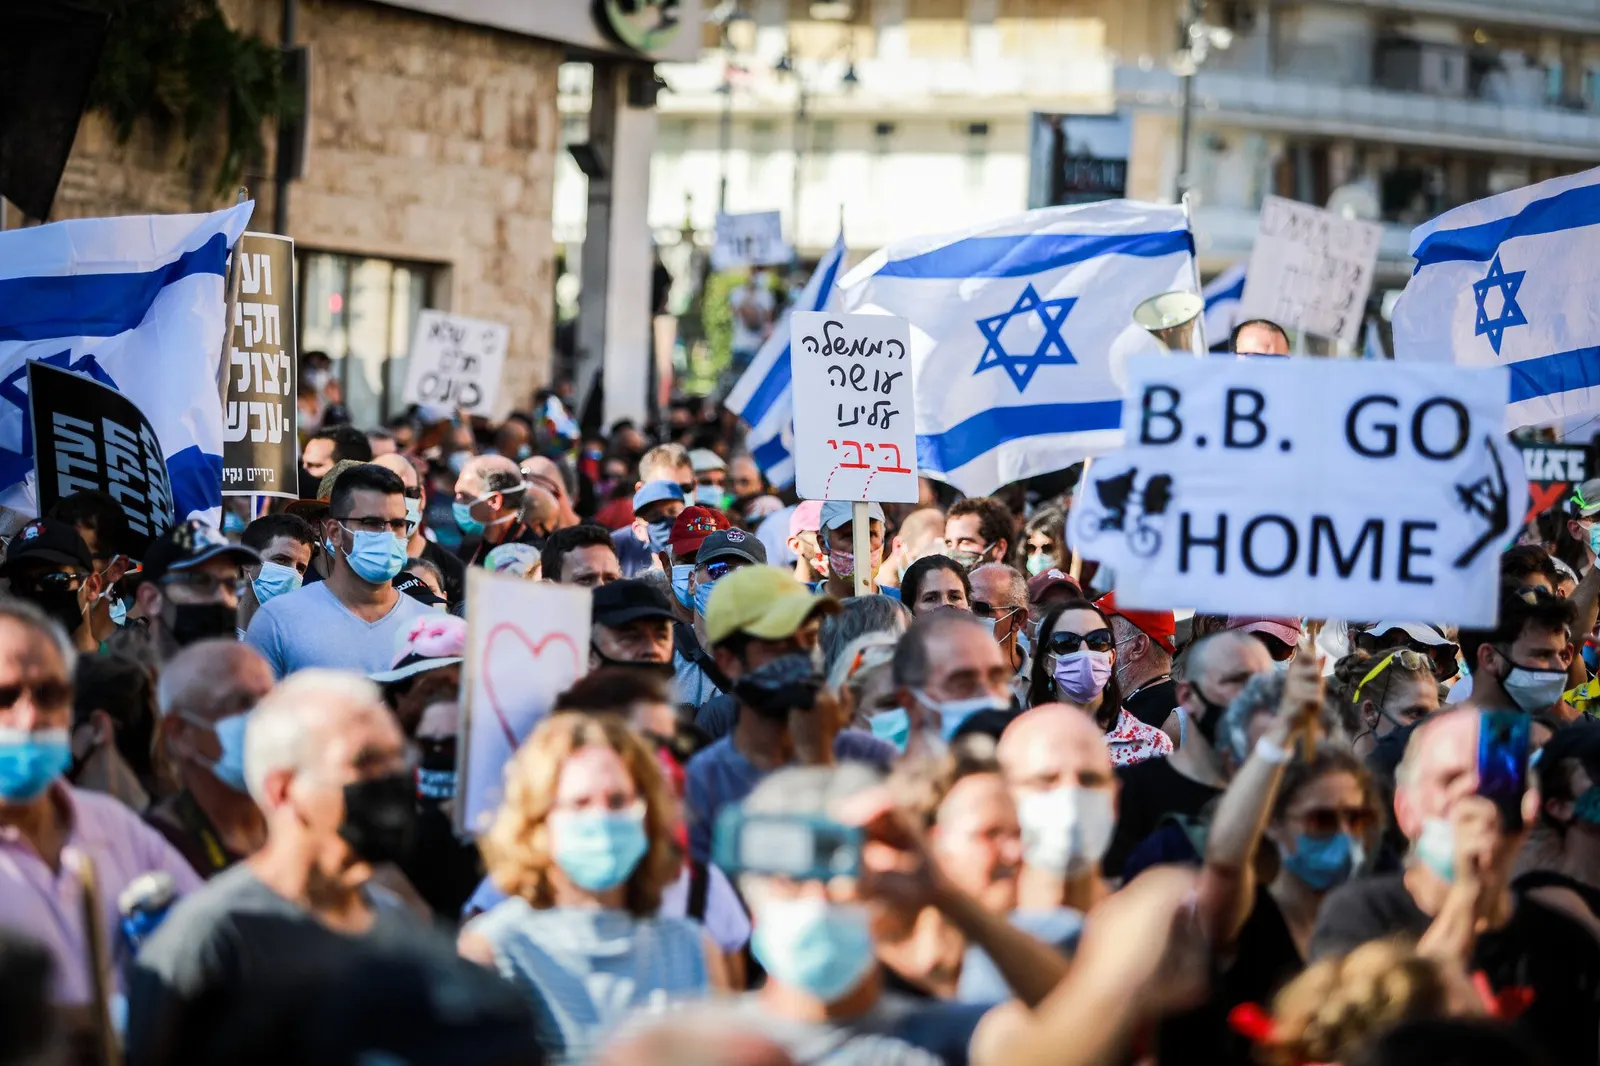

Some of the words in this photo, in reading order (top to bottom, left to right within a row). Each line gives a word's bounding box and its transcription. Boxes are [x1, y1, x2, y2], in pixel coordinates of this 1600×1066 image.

[235, 302, 280, 347] חקי
[801, 320, 905, 359] הממשלה
[231, 350, 291, 396] לצול
[827, 363, 903, 395] עושה
[837, 401, 900, 430] עלינו
[1139, 384, 1292, 452] B.B.
[1345, 394, 1471, 460] GO
[246, 467, 274, 482] בידיים
[826, 439, 912, 474] ביבי
[222, 467, 243, 484] נקיו
[1178, 512, 1437, 586] HOME
